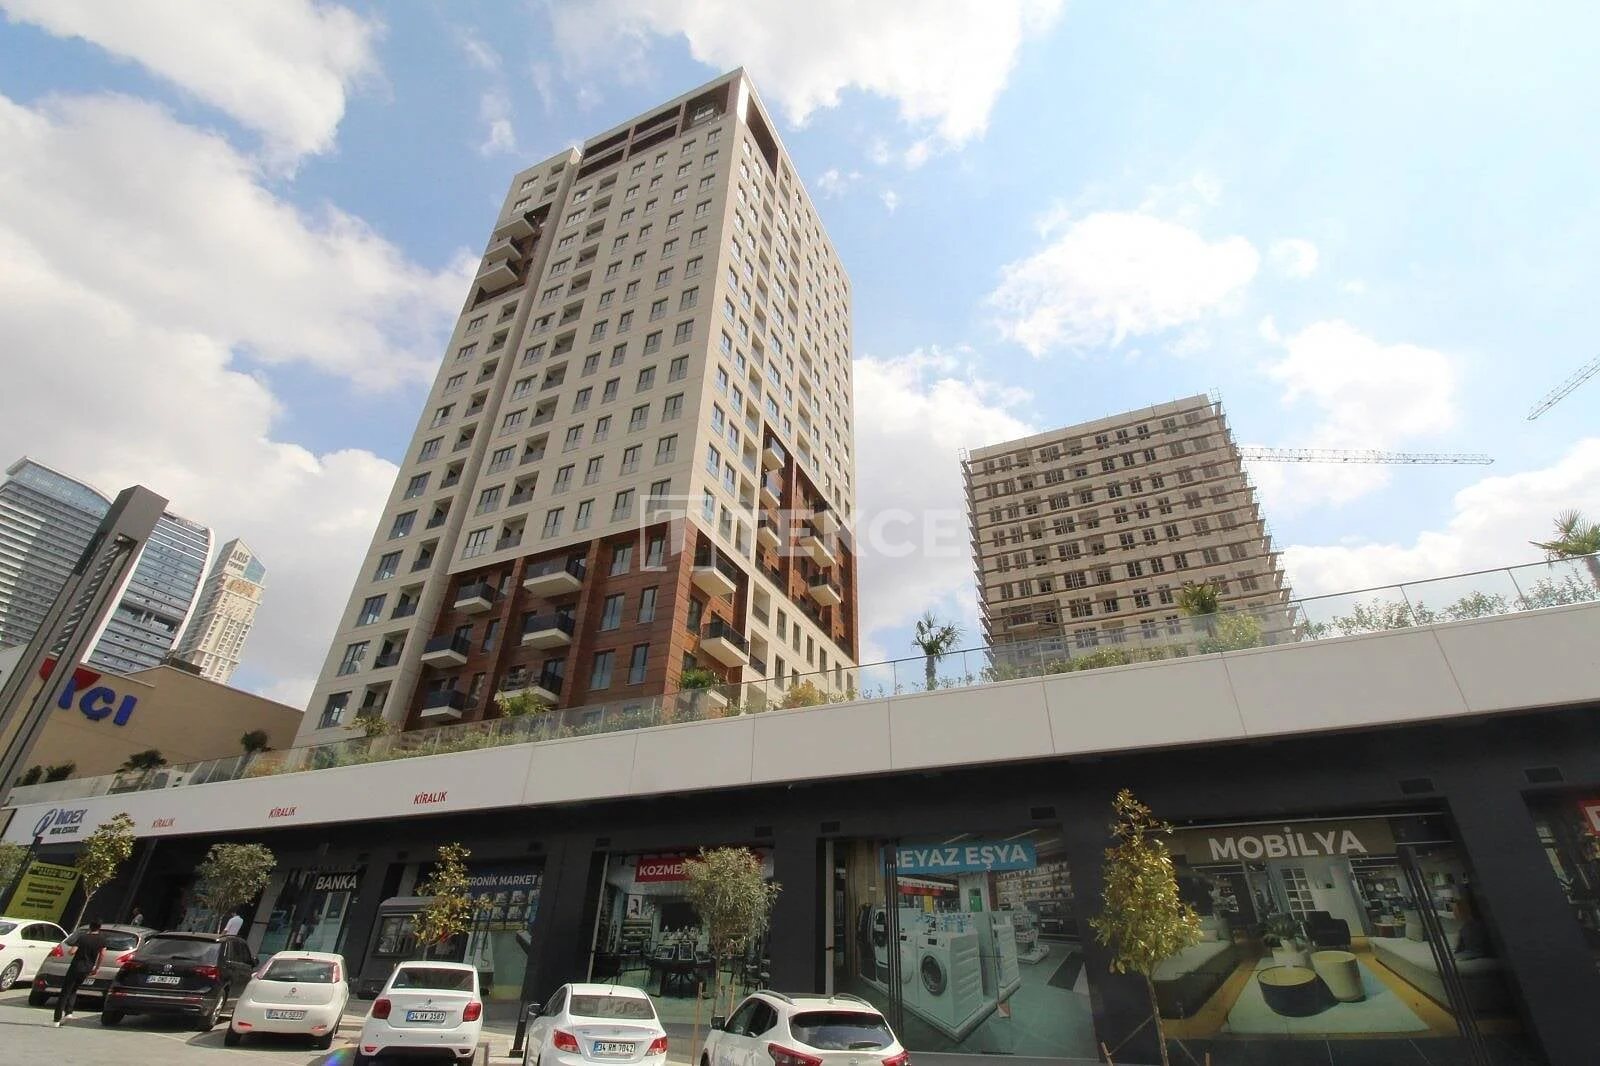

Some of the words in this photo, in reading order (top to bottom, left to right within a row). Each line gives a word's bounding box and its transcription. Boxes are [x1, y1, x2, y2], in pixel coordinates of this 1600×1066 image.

[230, 550, 250, 564] ARIS
[413, 791, 448, 805] KİRALIK
[268, 806, 298, 819] KİRALIK
[151, 817, 175, 829] KİRALIK
[1208, 826, 1368, 861] MOBİLYA
[896, 847, 960, 869] EYAZ
[965, 843, 1029, 872] EŞYA
[639, 863, 686, 877] KOZME
[315, 875, 358, 890] BANKA
[498, 874, 538, 886] MARKET
